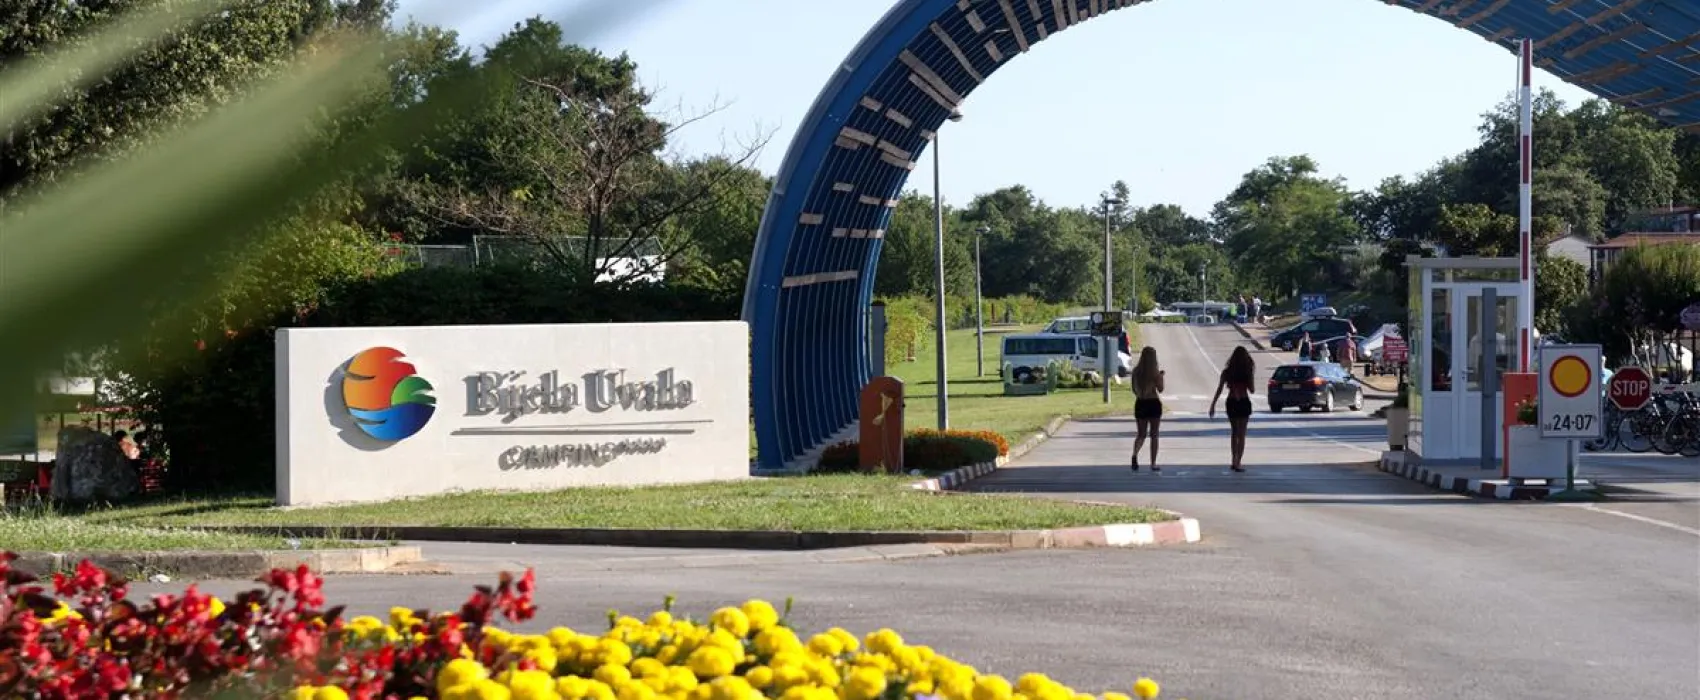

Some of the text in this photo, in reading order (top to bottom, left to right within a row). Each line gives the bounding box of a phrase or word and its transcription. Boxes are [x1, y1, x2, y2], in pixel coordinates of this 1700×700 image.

[464, 367, 695, 424] Bijela Uvala
[1613, 380, 1648, 396] STOP
